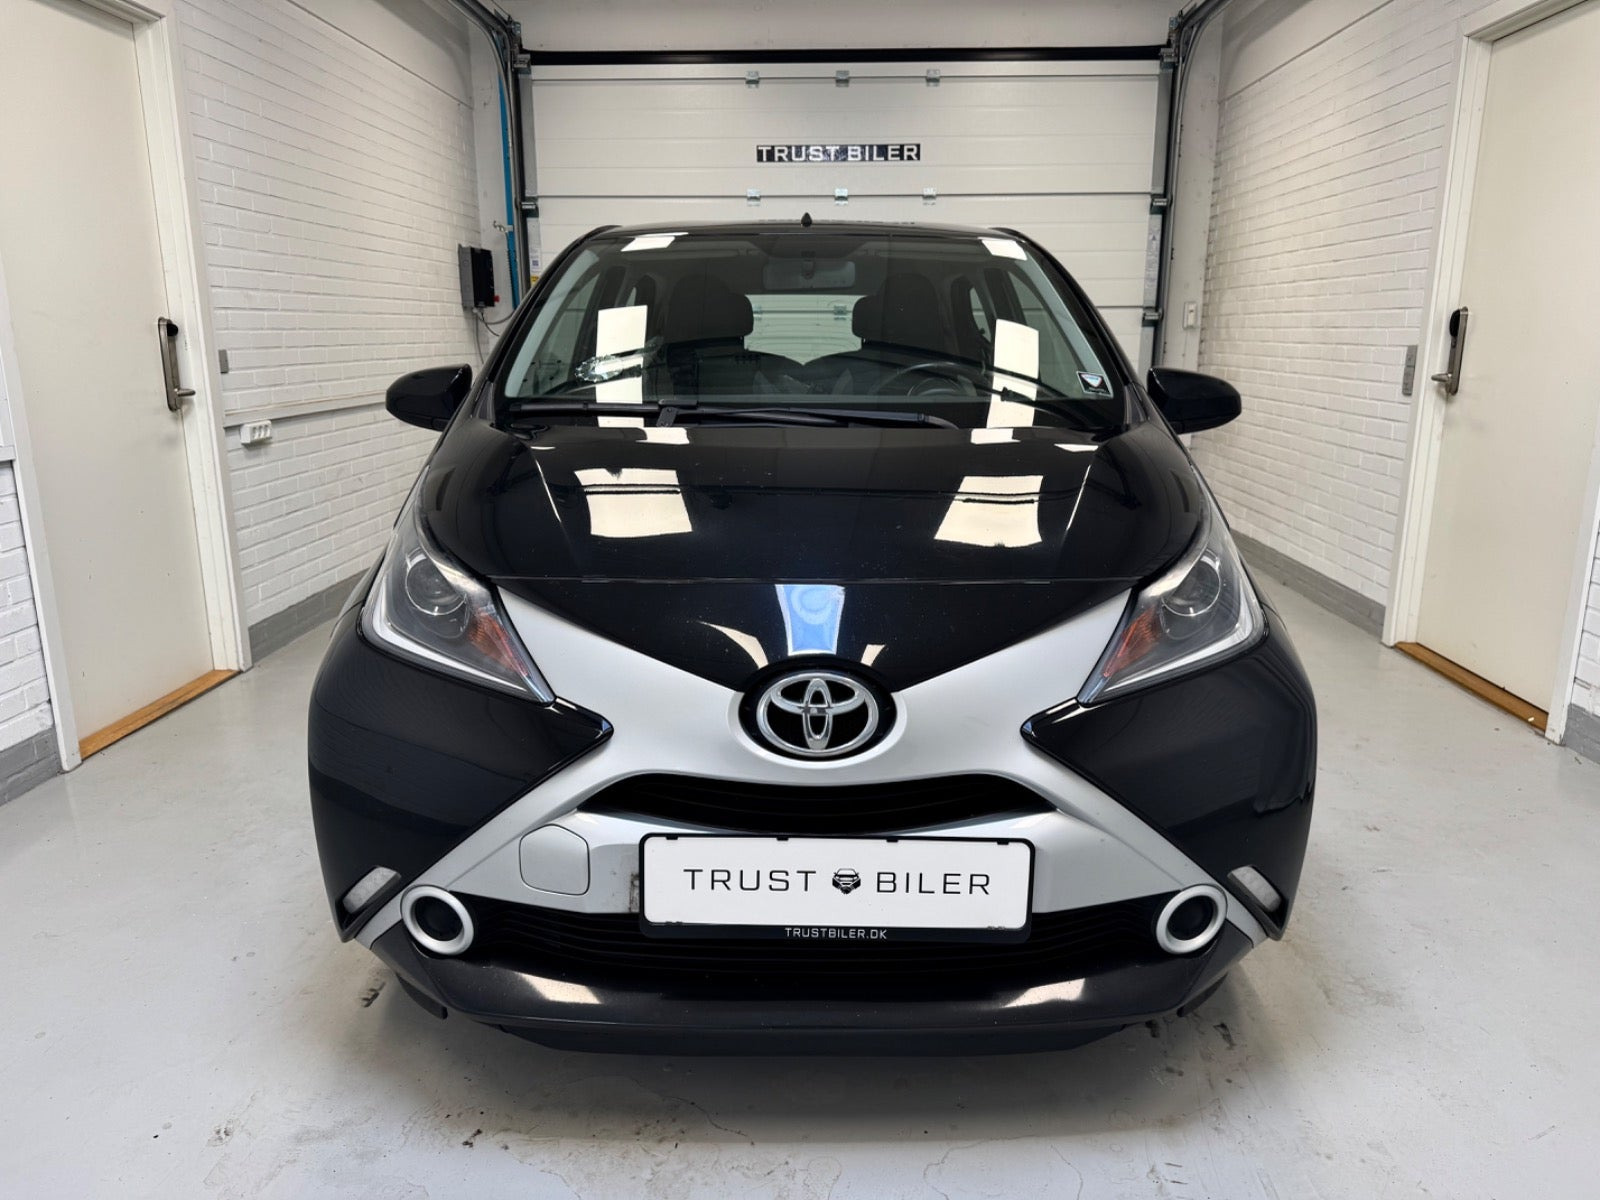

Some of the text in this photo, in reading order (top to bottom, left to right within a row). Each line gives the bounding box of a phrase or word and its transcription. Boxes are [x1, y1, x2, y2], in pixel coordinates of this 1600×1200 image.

[758, 144, 919, 162] TRUST BILER
[683, 869, 991, 895] TRUST BILER
[785, 927, 888, 940] TRUSTBILER.DK
